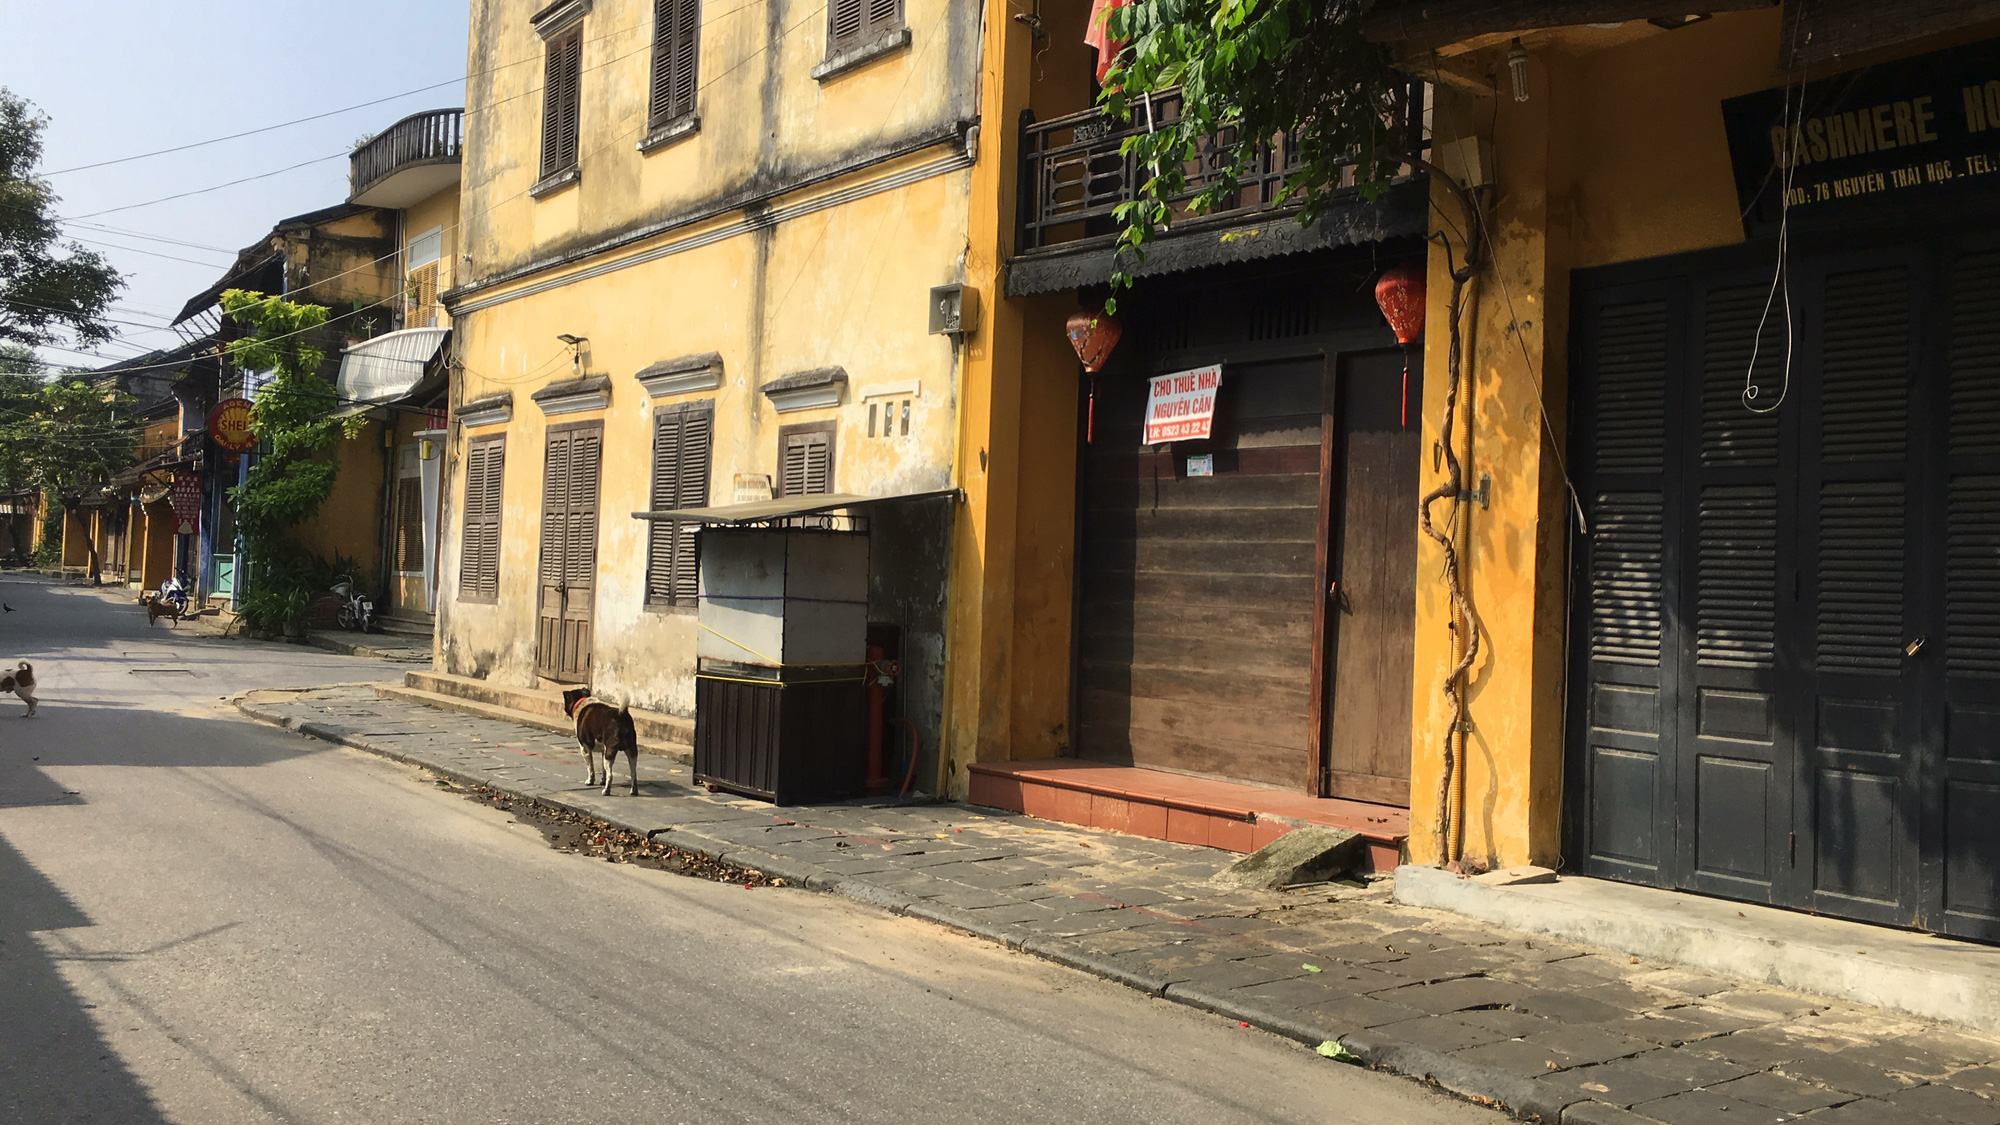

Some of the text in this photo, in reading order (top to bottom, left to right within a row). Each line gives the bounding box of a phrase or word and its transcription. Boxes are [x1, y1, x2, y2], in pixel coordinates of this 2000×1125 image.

[1770, 95, 1938, 169] CASHMERE
[1814, 181, 1830, 202] 76
[1834, 166, 1886, 199] NGUYỄN
[1890, 163, 1922, 190] THÁI
[1926, 159, 1953, 185] HỌC
[1153, 368, 1217, 398] CHO THUÊ NHÀ
[222, 400, 251, 410] AGEN
[1153, 394, 1212, 419] NGUYÊN CĂN
[1150, 427, 1161, 438] LH:
[1161, 424, 1180, 438] 0523
[1180, 422, 1190, 435] 43
[1191, 421, 1201, 433] 22
